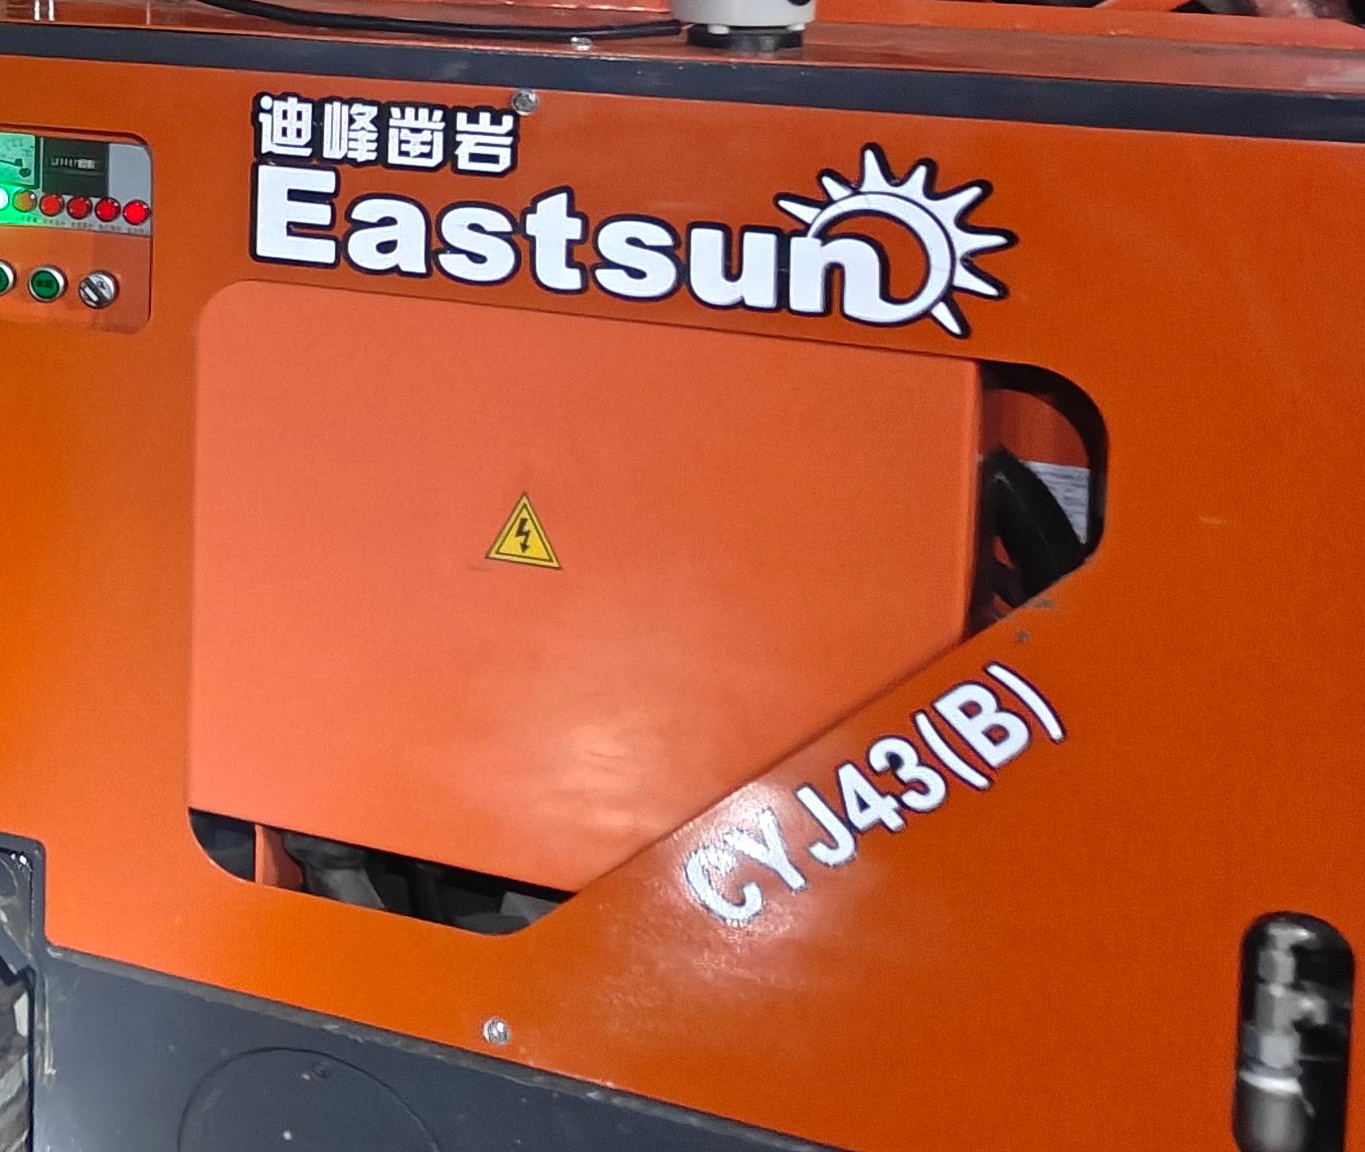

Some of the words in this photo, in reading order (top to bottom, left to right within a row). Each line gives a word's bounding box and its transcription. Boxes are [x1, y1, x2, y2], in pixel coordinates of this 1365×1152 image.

[258, 95, 515, 173] 迪峰凿岩
[254, 162, 956, 325] Eastsun
[684, 662, 1067, 927] CYJ43(B)
